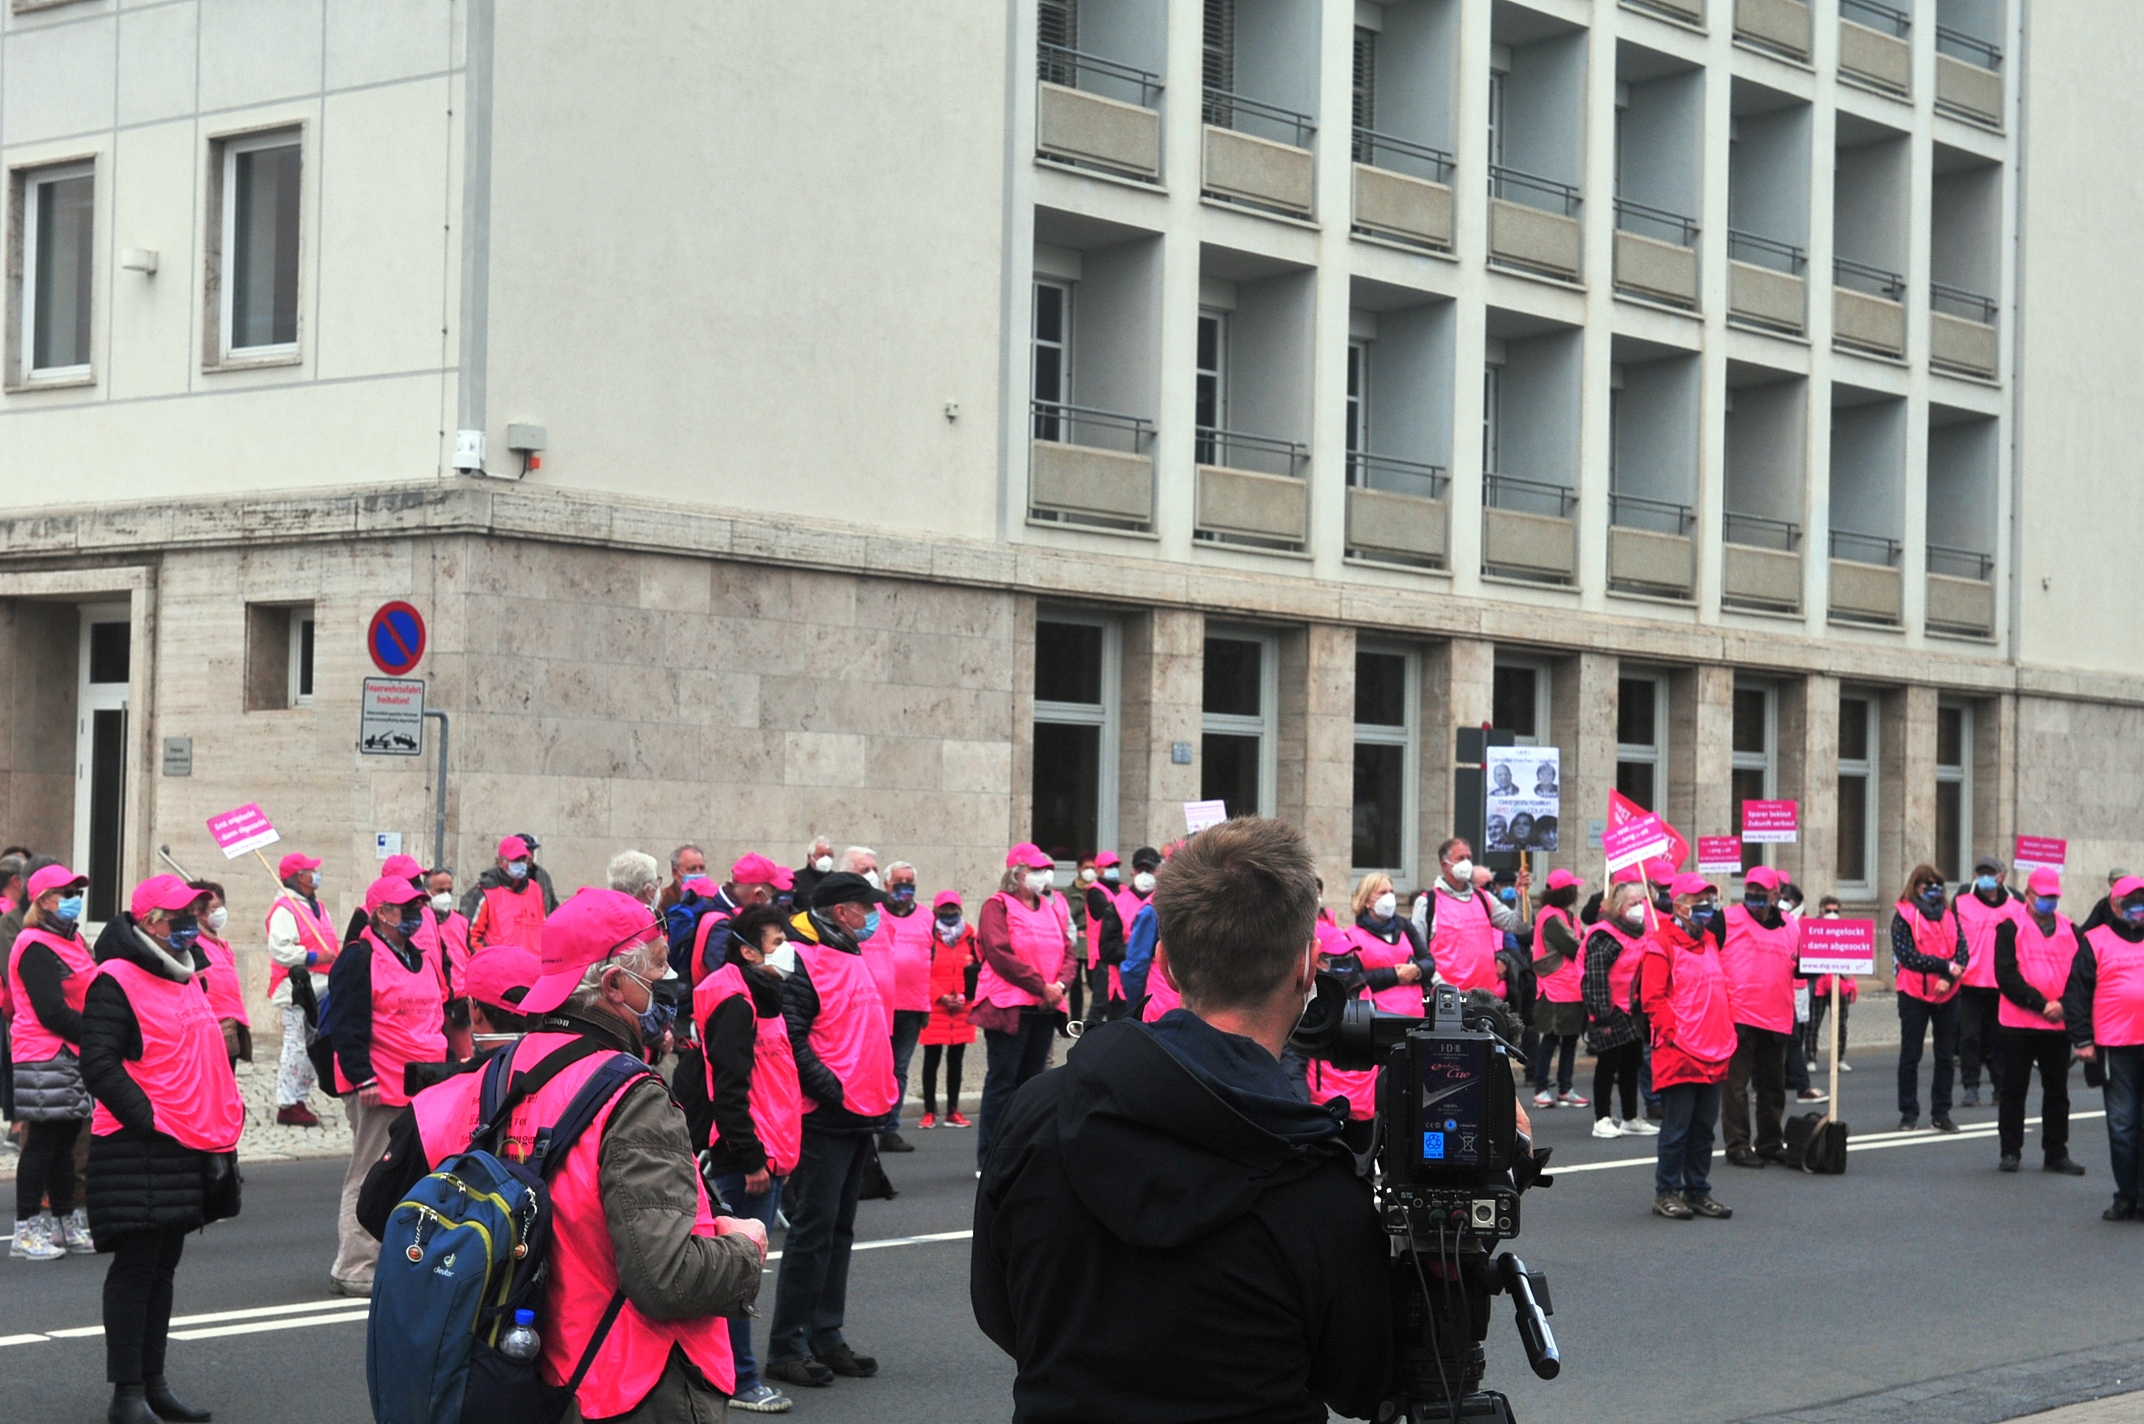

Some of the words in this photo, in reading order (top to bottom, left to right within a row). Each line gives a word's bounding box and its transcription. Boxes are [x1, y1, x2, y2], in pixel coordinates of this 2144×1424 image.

[1808, 926, 1824, 935] Erst
[1825, 926, 1865, 937] angelockt
[1807, 941, 1829, 949] dann
[1830, 941, 1870, 952] abgezockt
[1446, 1068, 1471, 1079] Cue
[433, 1265, 454, 1278] deuter
